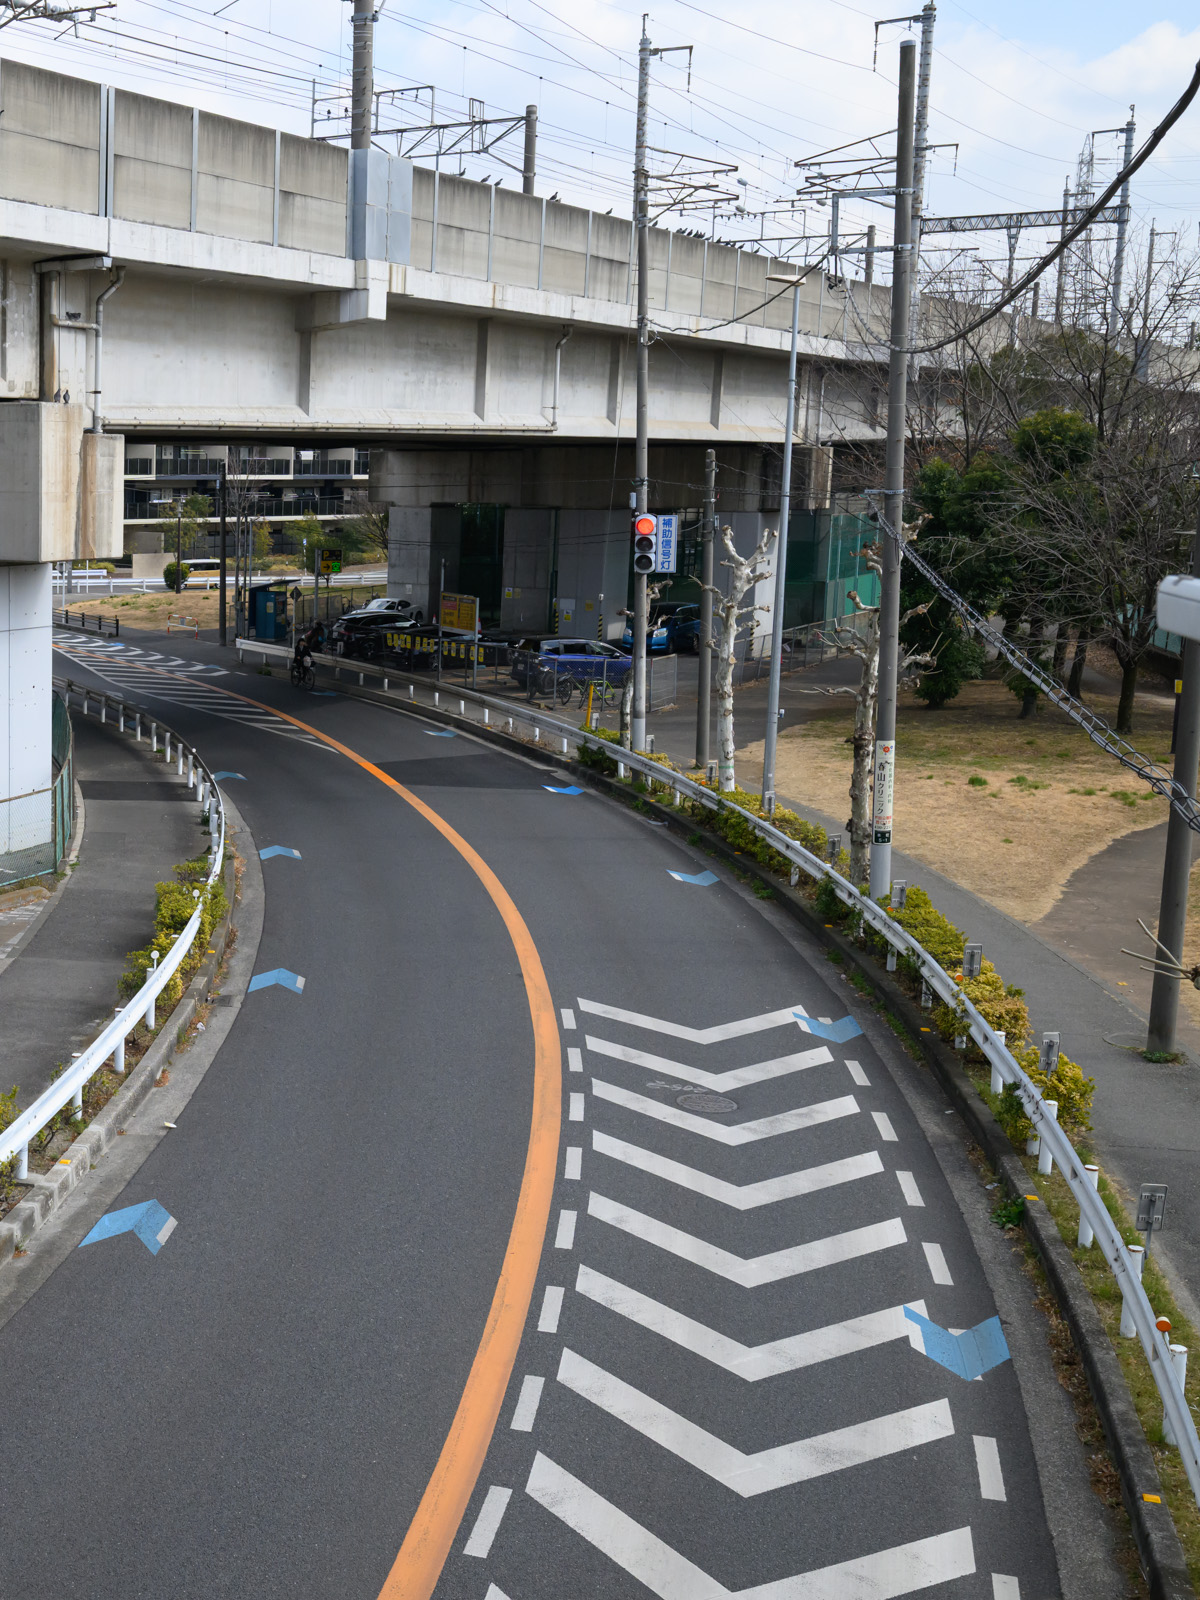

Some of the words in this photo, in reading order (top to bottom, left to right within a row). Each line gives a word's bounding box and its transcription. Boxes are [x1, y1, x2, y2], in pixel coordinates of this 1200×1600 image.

[661, 518, 672, 570] 補助信号灯
